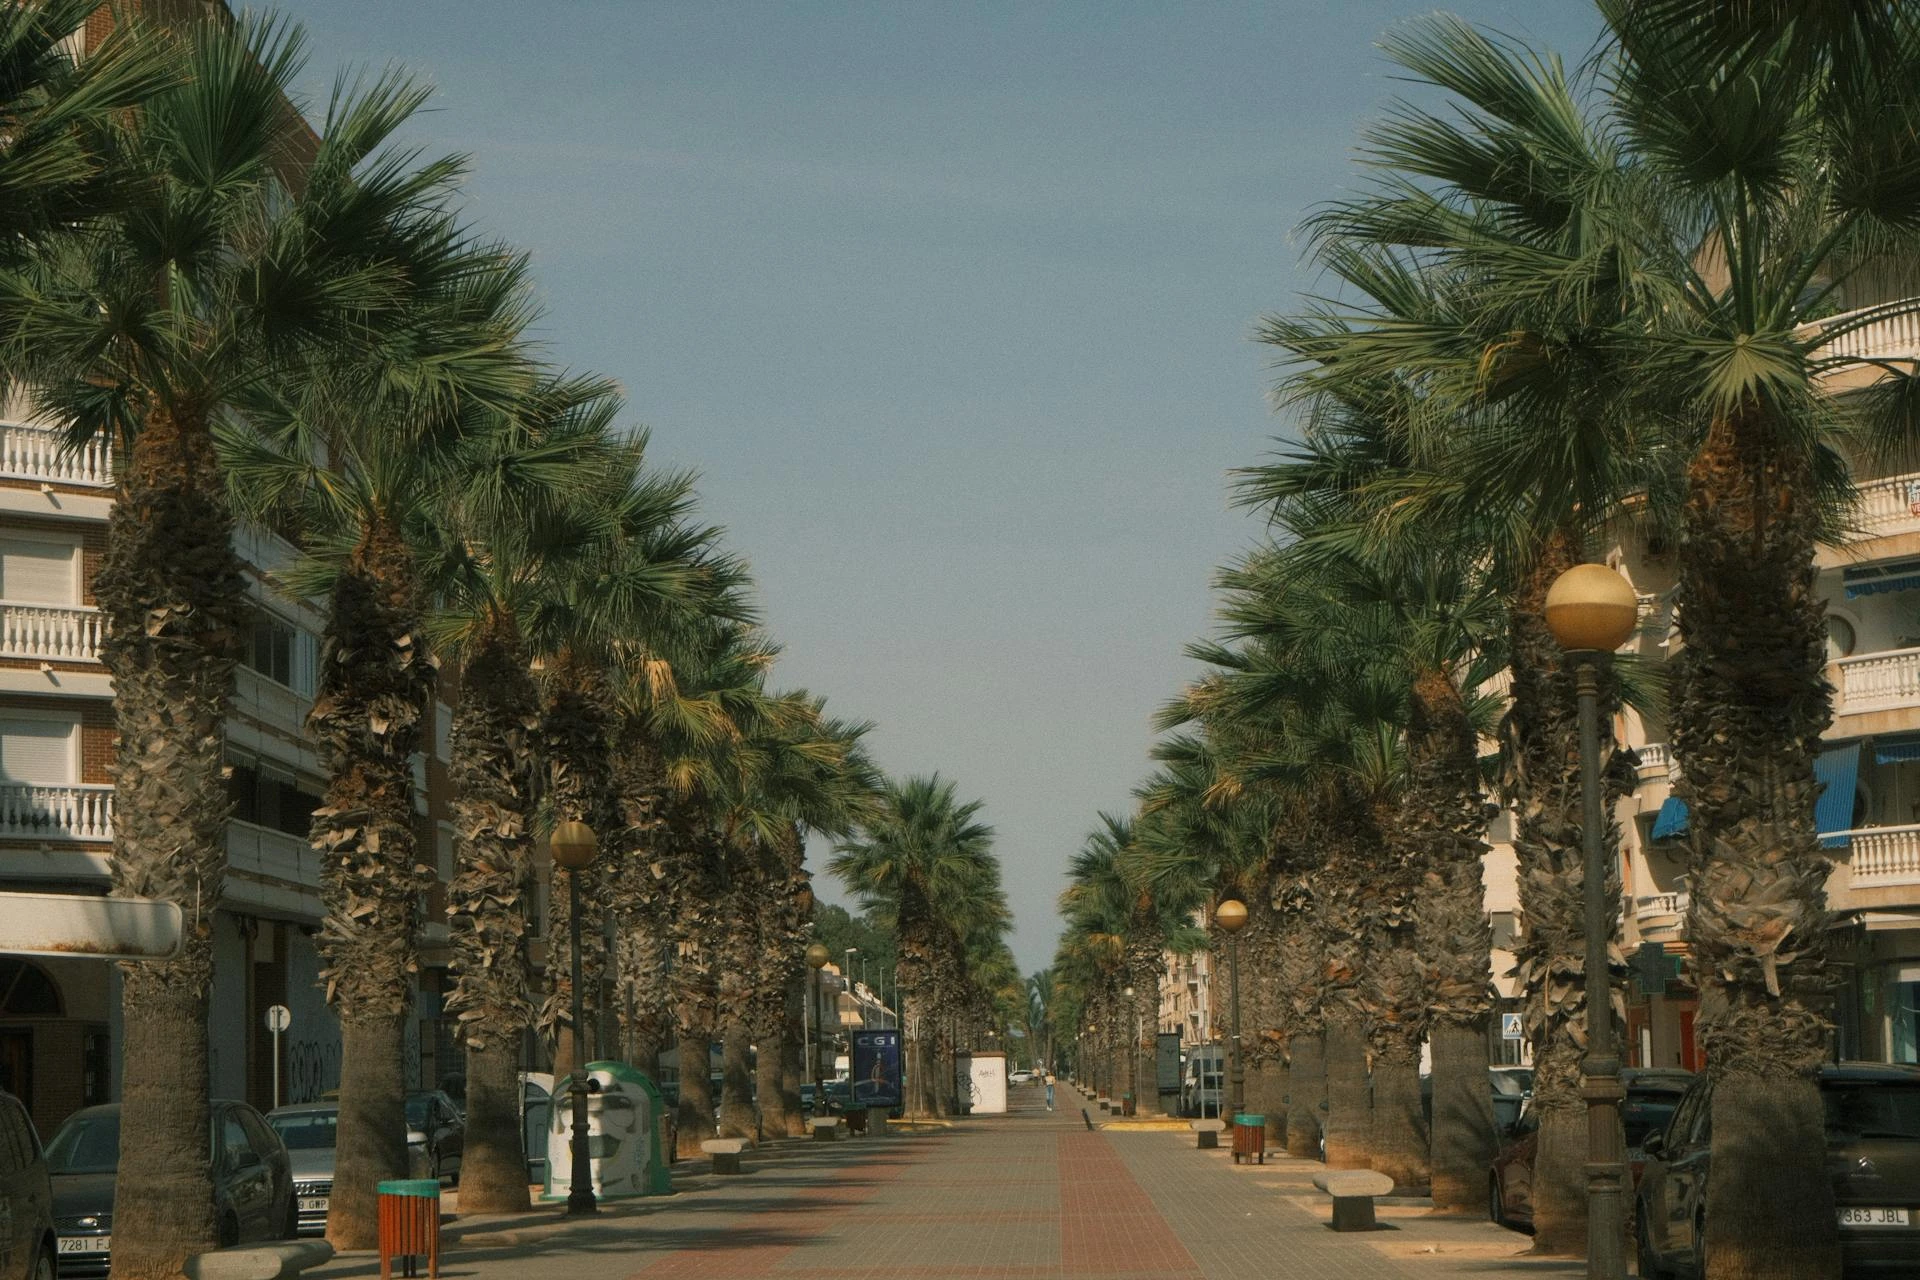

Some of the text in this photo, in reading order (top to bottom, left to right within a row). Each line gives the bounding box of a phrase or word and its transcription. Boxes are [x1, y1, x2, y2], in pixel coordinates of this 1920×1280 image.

[857, 1036, 896, 1045] CGI
[1878, 1209, 1905, 1223] JBL
[60, 1238, 112, 1251] 7281 FJ
